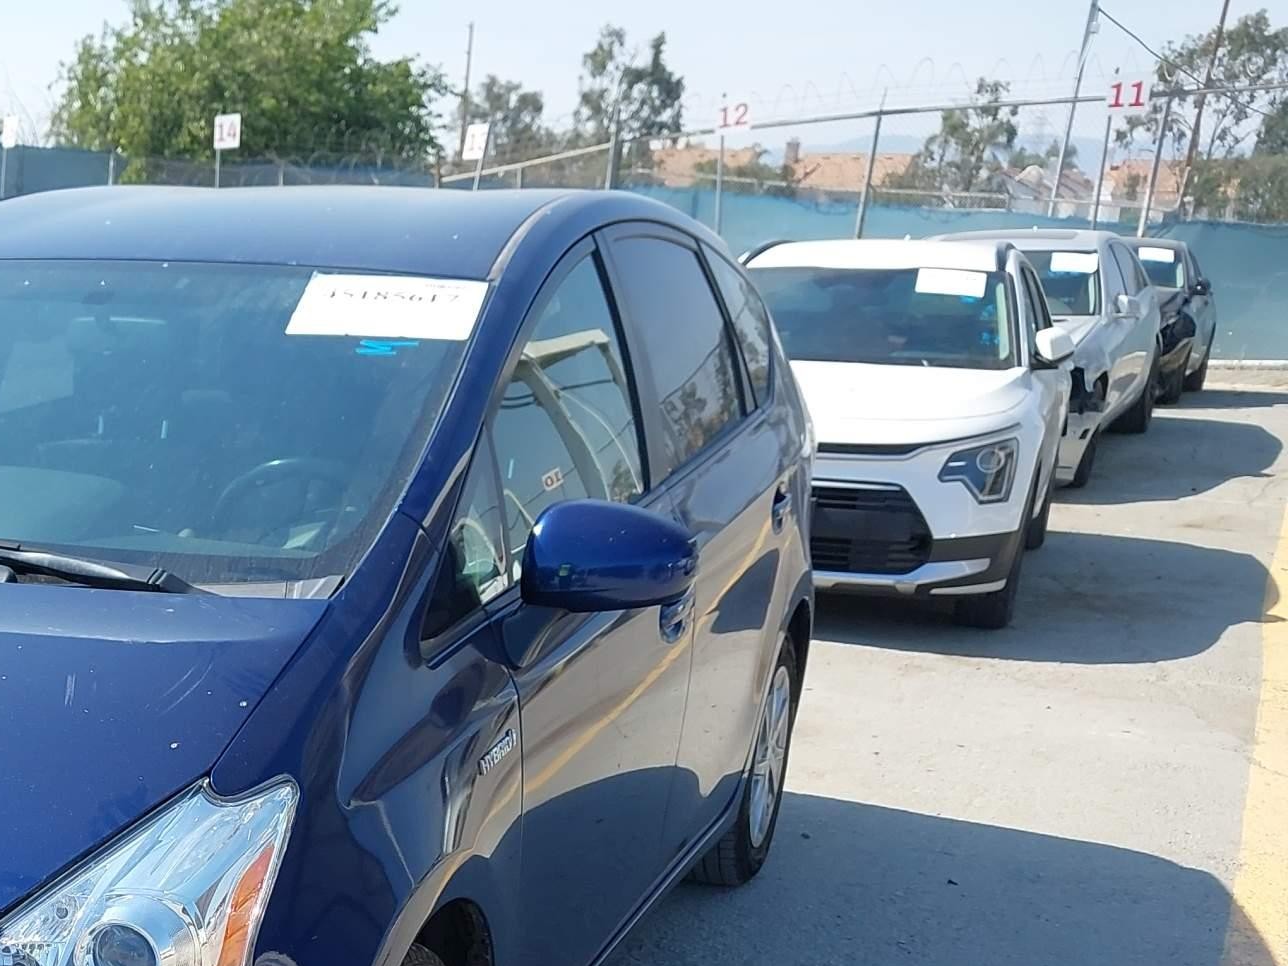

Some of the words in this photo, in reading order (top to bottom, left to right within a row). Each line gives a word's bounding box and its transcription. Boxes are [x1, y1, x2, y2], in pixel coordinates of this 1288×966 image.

[1108, 81, 1144, 107] 11
[719, 104, 749, 128] 12
[217, 122, 236, 142] 14
